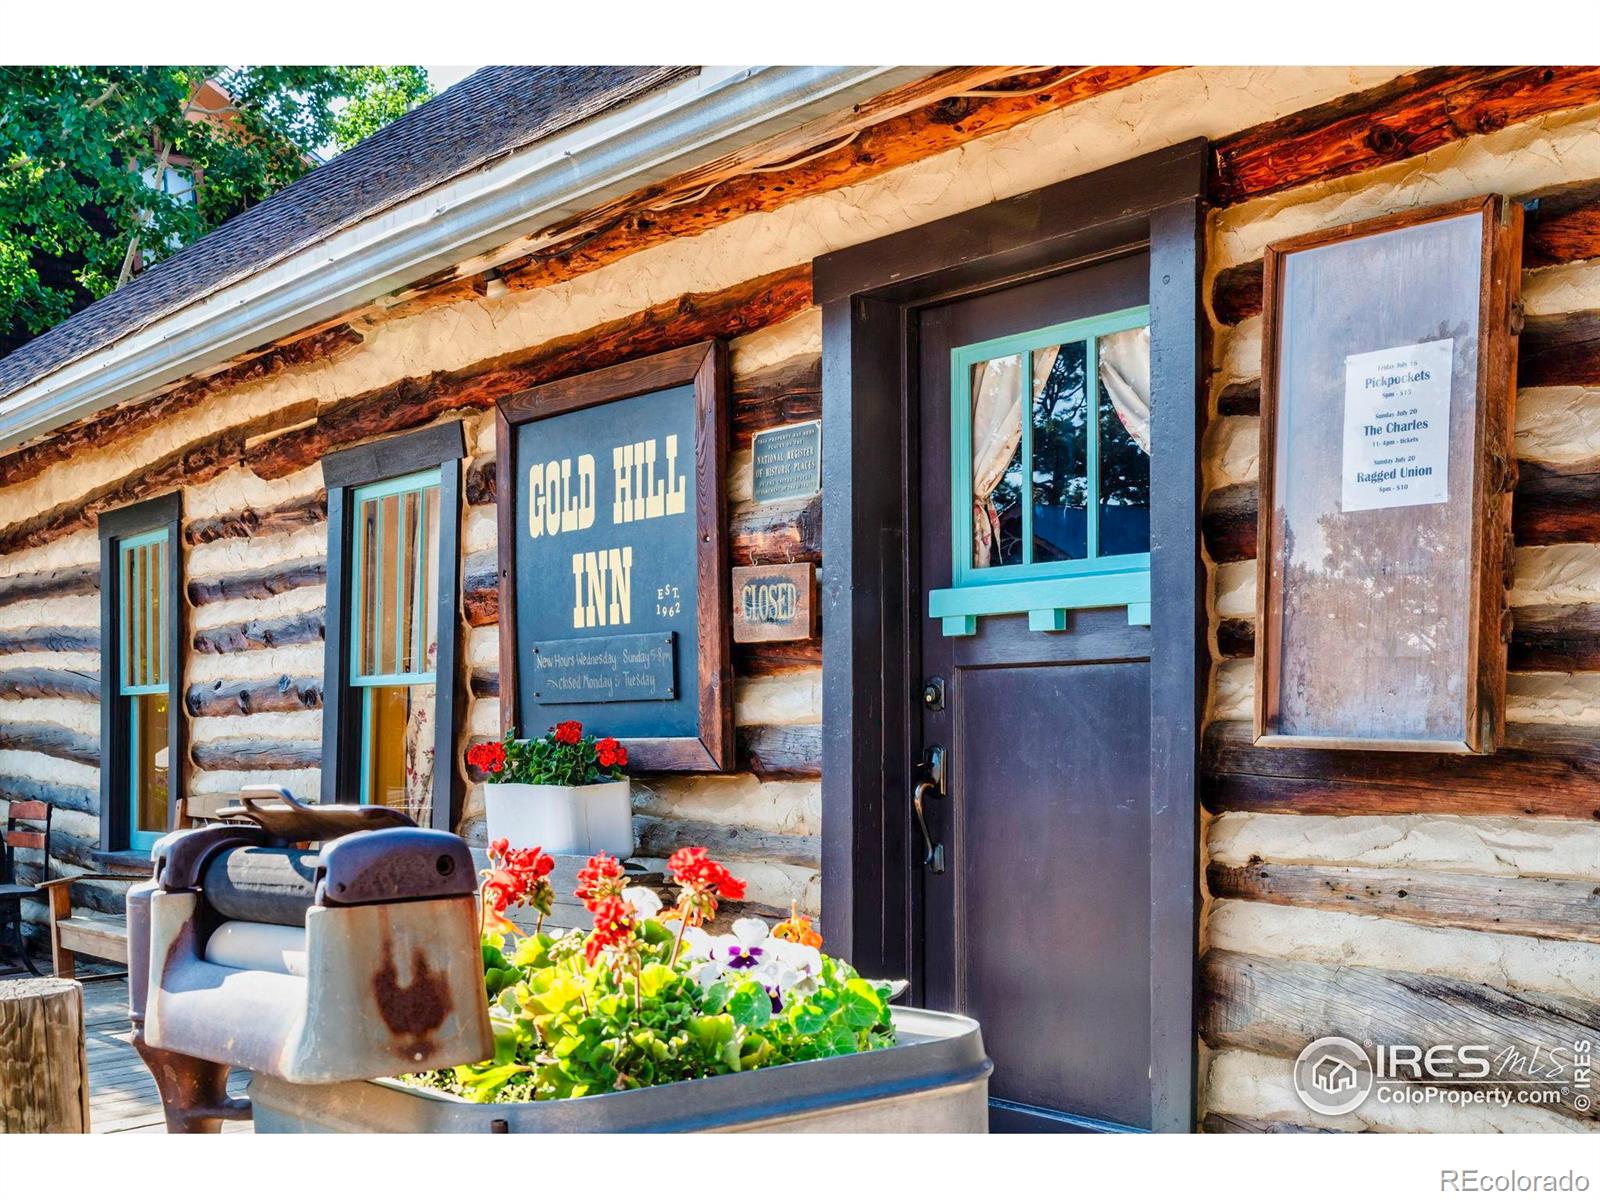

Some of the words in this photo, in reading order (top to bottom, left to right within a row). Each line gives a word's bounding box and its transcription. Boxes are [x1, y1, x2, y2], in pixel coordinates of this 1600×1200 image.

[1365, 370, 1431, 388] Pickpockets
[1376, 411, 1395, 419] Sunday
[1397, 409, 1408, 417] July
[1364, 425, 1383, 436] The
[1386, 419, 1429, 434] Charles
[768, 434, 791, 442] PROPERTY
[1400, 436, 1419, 444] tickets
[757, 452, 784, 464] NATIONAL
[787, 446, 814, 459] REGISTER
[1374, 458, 1393, 466] Sunday
[1395, 456, 1406, 464] July
[756, 469, 763, 478] OF
[766, 463, 791, 478] HISTORIC
[794, 460, 816, 472] PLACES
[1357, 468, 1396, 484] Ragged
[1400, 466, 1432, 478] Union
[528, 453, 596, 538] GOLD
[612, 434, 686, 524] HILL
[572, 546, 633, 629] INN
[657, 584, 680, 600] EST.
[656, 602, 681, 618] 1962
[742, 582, 797, 621] CLOSED
[537, 654, 553, 669] New
[554, 654, 575, 668] Hours
[576, 650, 617, 671] Wednesday
[622, 648, 650, 670] Sunday
[582, 674, 614, 697] Monday
[622, 670, 656, 695] Tuesday
